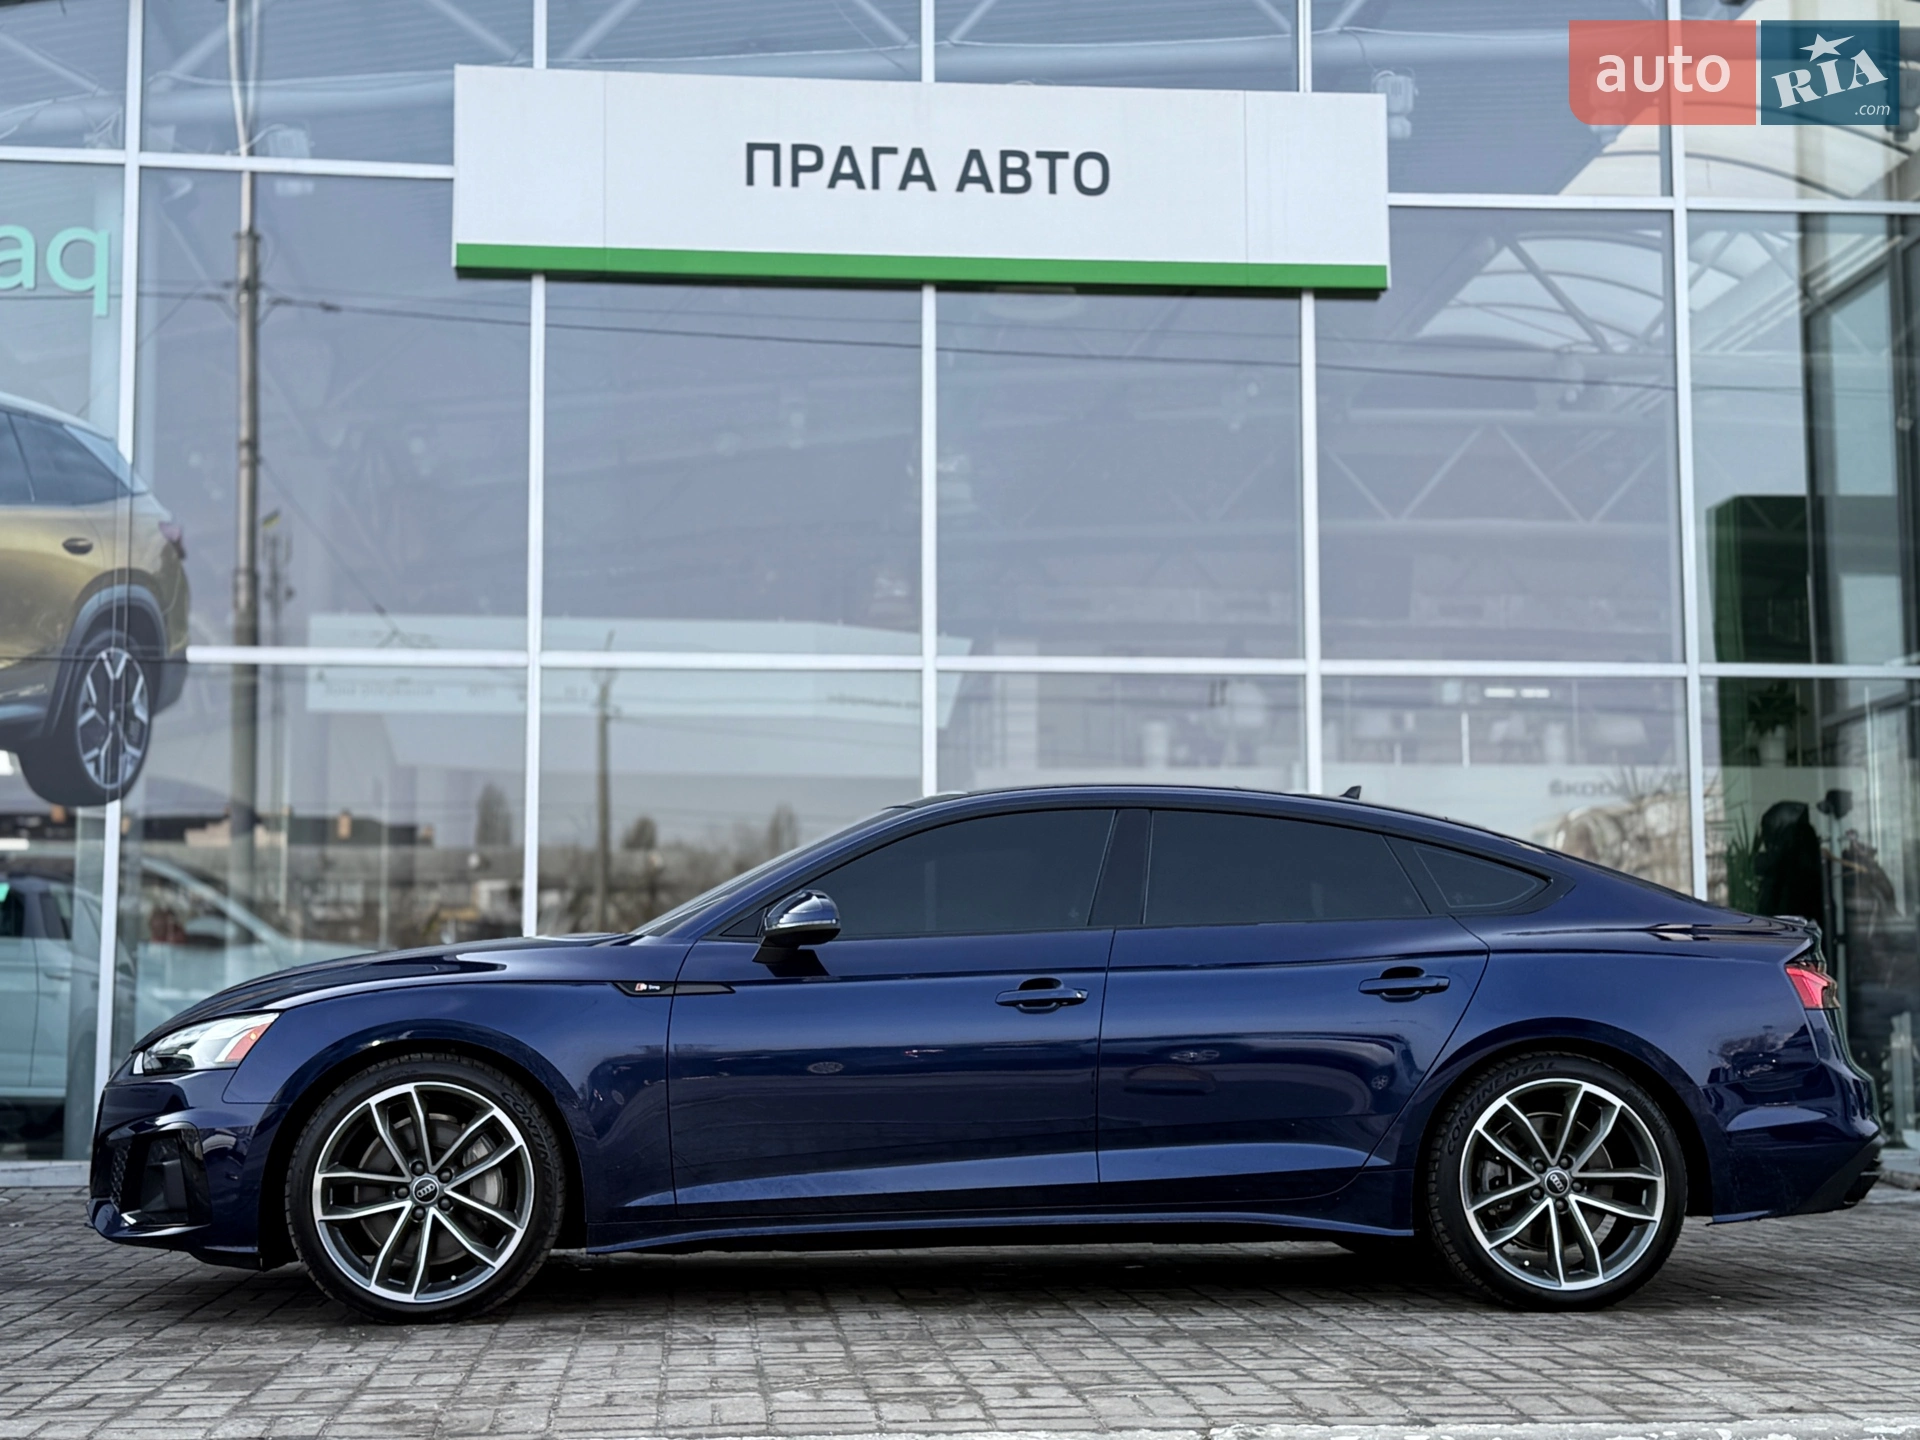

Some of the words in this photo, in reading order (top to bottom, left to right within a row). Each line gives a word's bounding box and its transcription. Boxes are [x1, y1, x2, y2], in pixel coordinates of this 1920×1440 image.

[745, 142, 937, 192] ПРАГА
[955, 148, 1111, 197] АВТО
[1447, 1059, 1558, 1156] CONTINENTAL
[501, 1091, 555, 1230] CONTINEN
